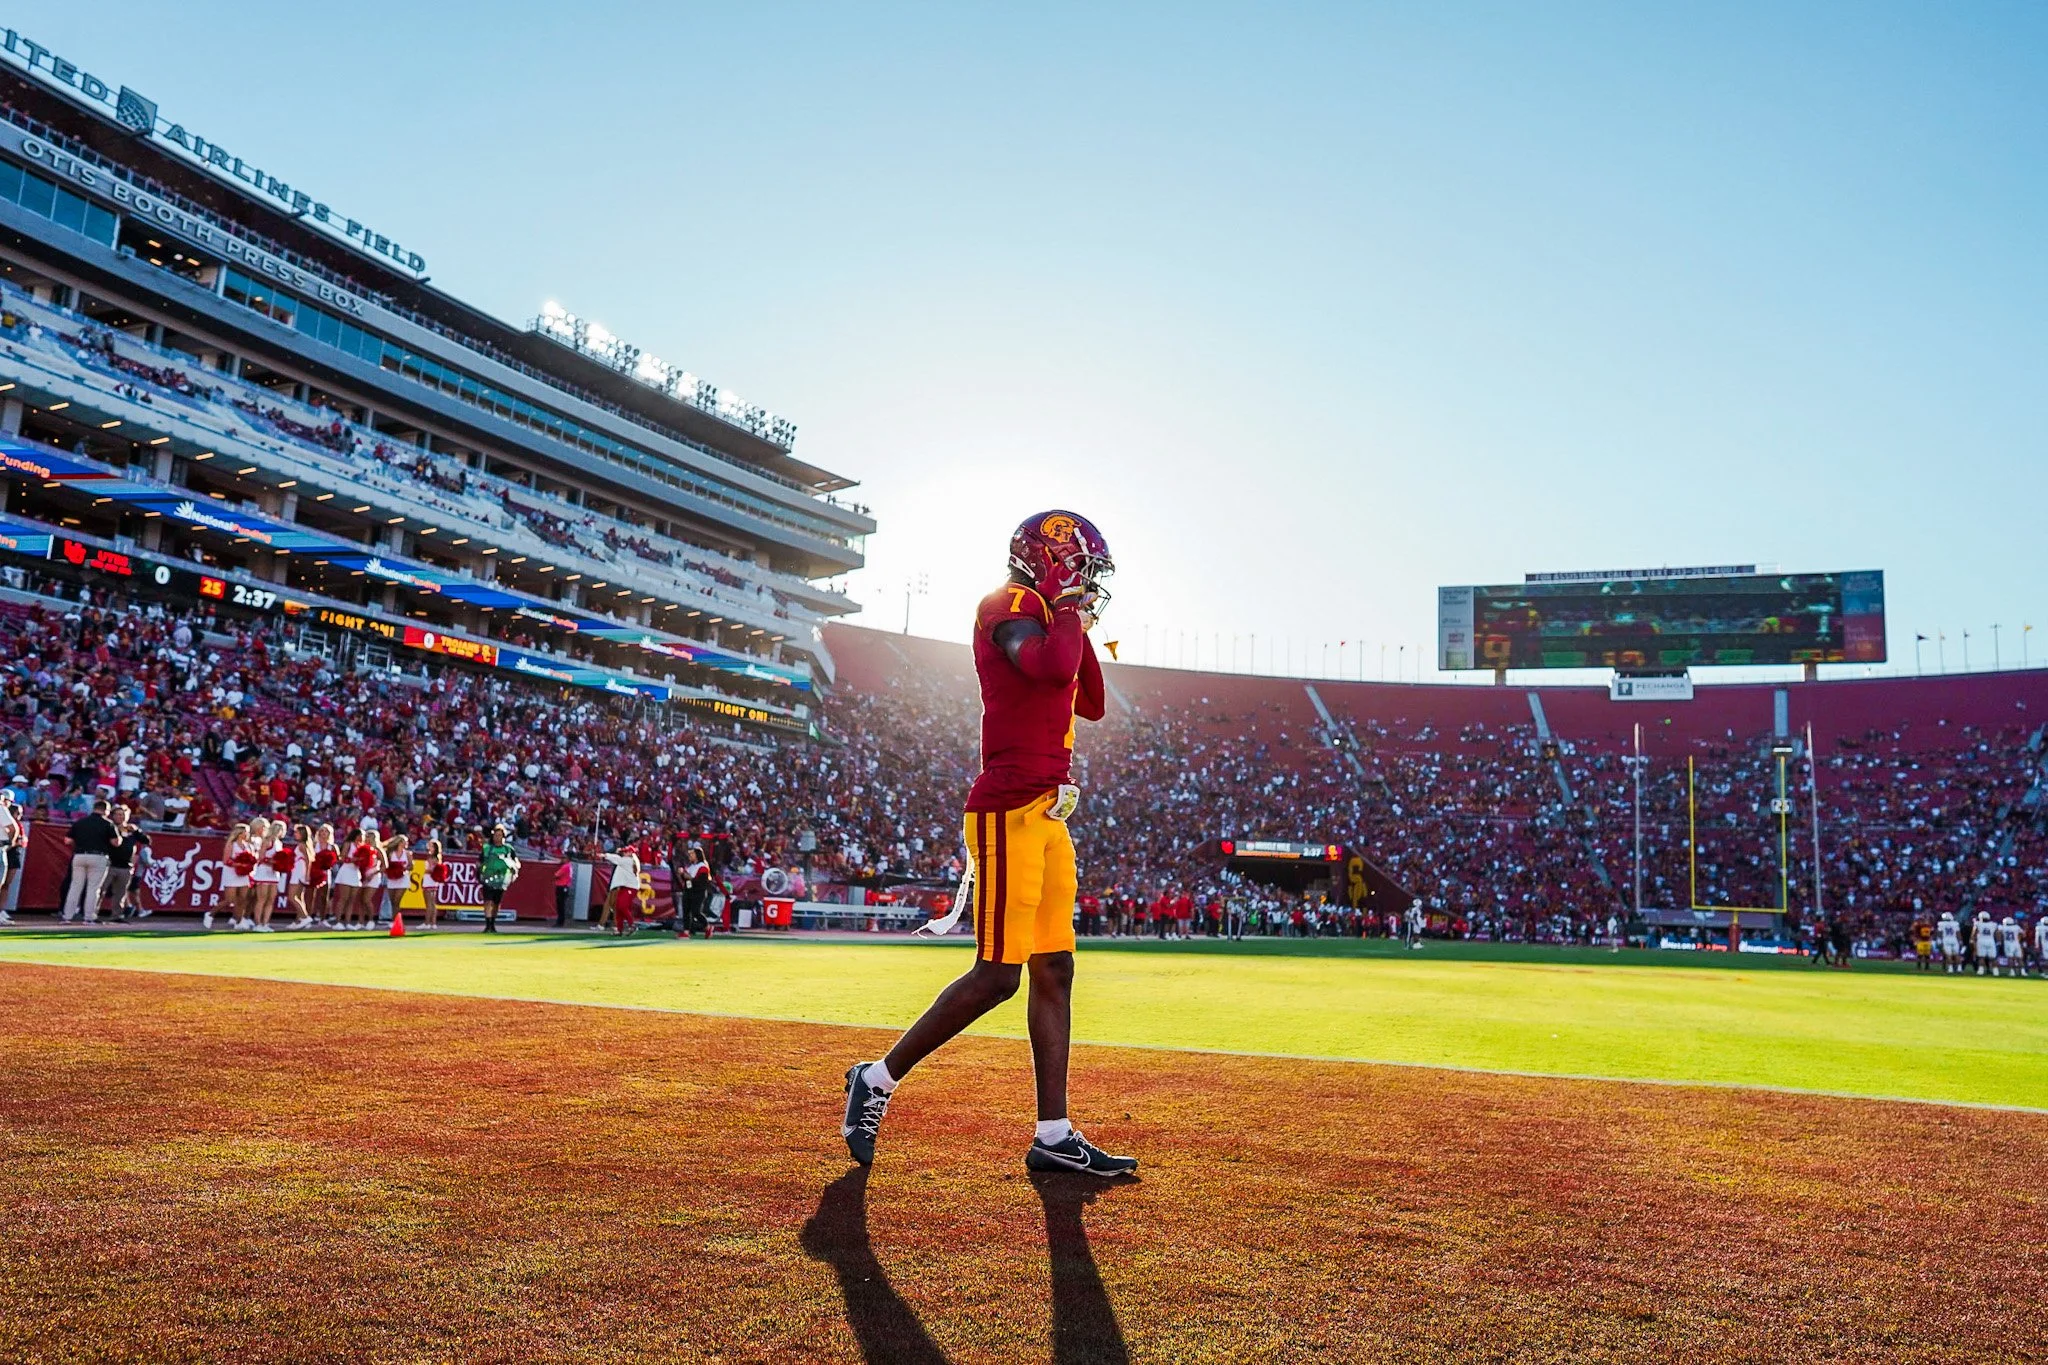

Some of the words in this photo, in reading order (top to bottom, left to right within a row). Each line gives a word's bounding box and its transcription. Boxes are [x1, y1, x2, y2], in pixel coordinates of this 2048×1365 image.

[4, 29, 108, 101] ITED
[163, 124, 330, 222] AIRLINES
[345, 218, 426, 272] FIELD
[21, 138, 96, 186] OTIS
[113, 182, 212, 242] BOOTH
[226, 239, 305, 288] PRESS
[318, 283, 363, 316] BOX
[155, 566, 170, 585] 0
[203, 579, 221, 595] 25
[233, 585, 277, 609] 2:37
[1007, 587, 1026, 613] 7
[320, 610, 365, 631] FIGHT
[714, 701, 746, 718] FIGHT
[749, 710, 768, 723] ON!
[766, 904, 779, 918] G
